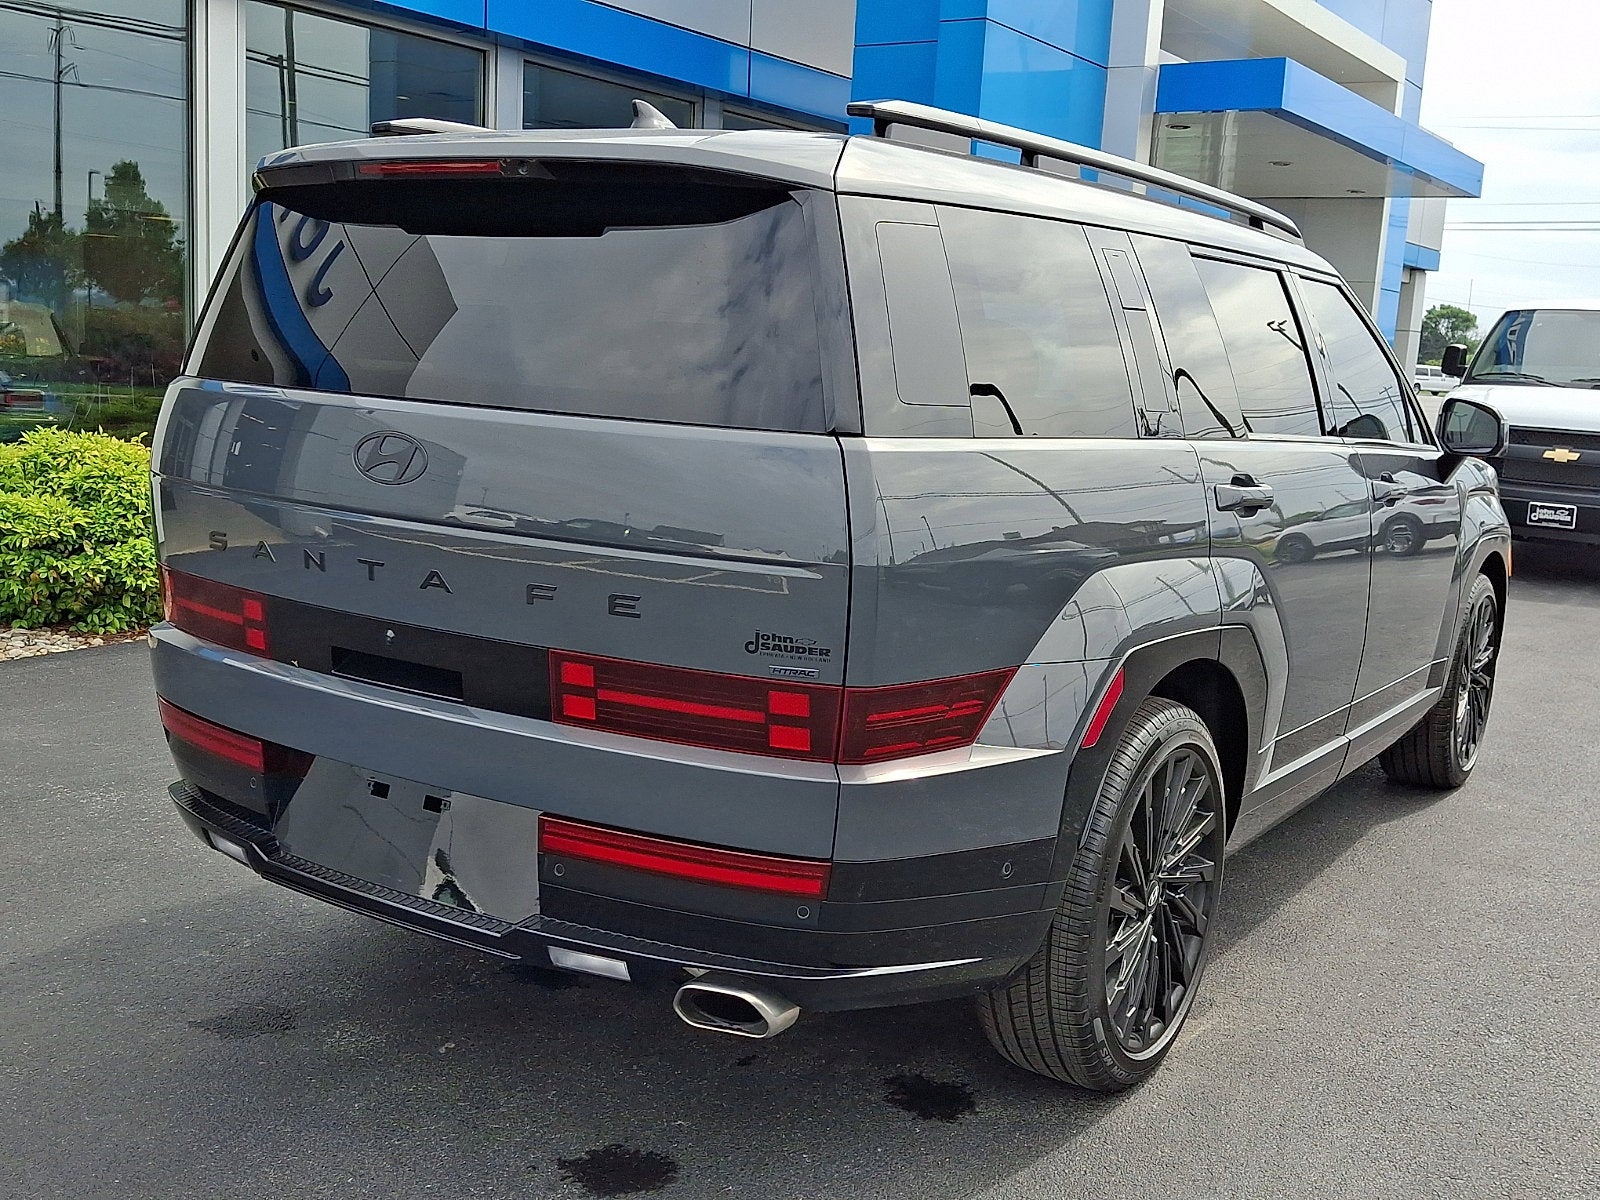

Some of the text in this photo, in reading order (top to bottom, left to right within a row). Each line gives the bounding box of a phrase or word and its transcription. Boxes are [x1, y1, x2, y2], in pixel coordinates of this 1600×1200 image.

[208, 529, 642, 619] SANTA FE
[760, 642, 832, 657] SAUDER
[772, 667, 816, 678] HTRAC
